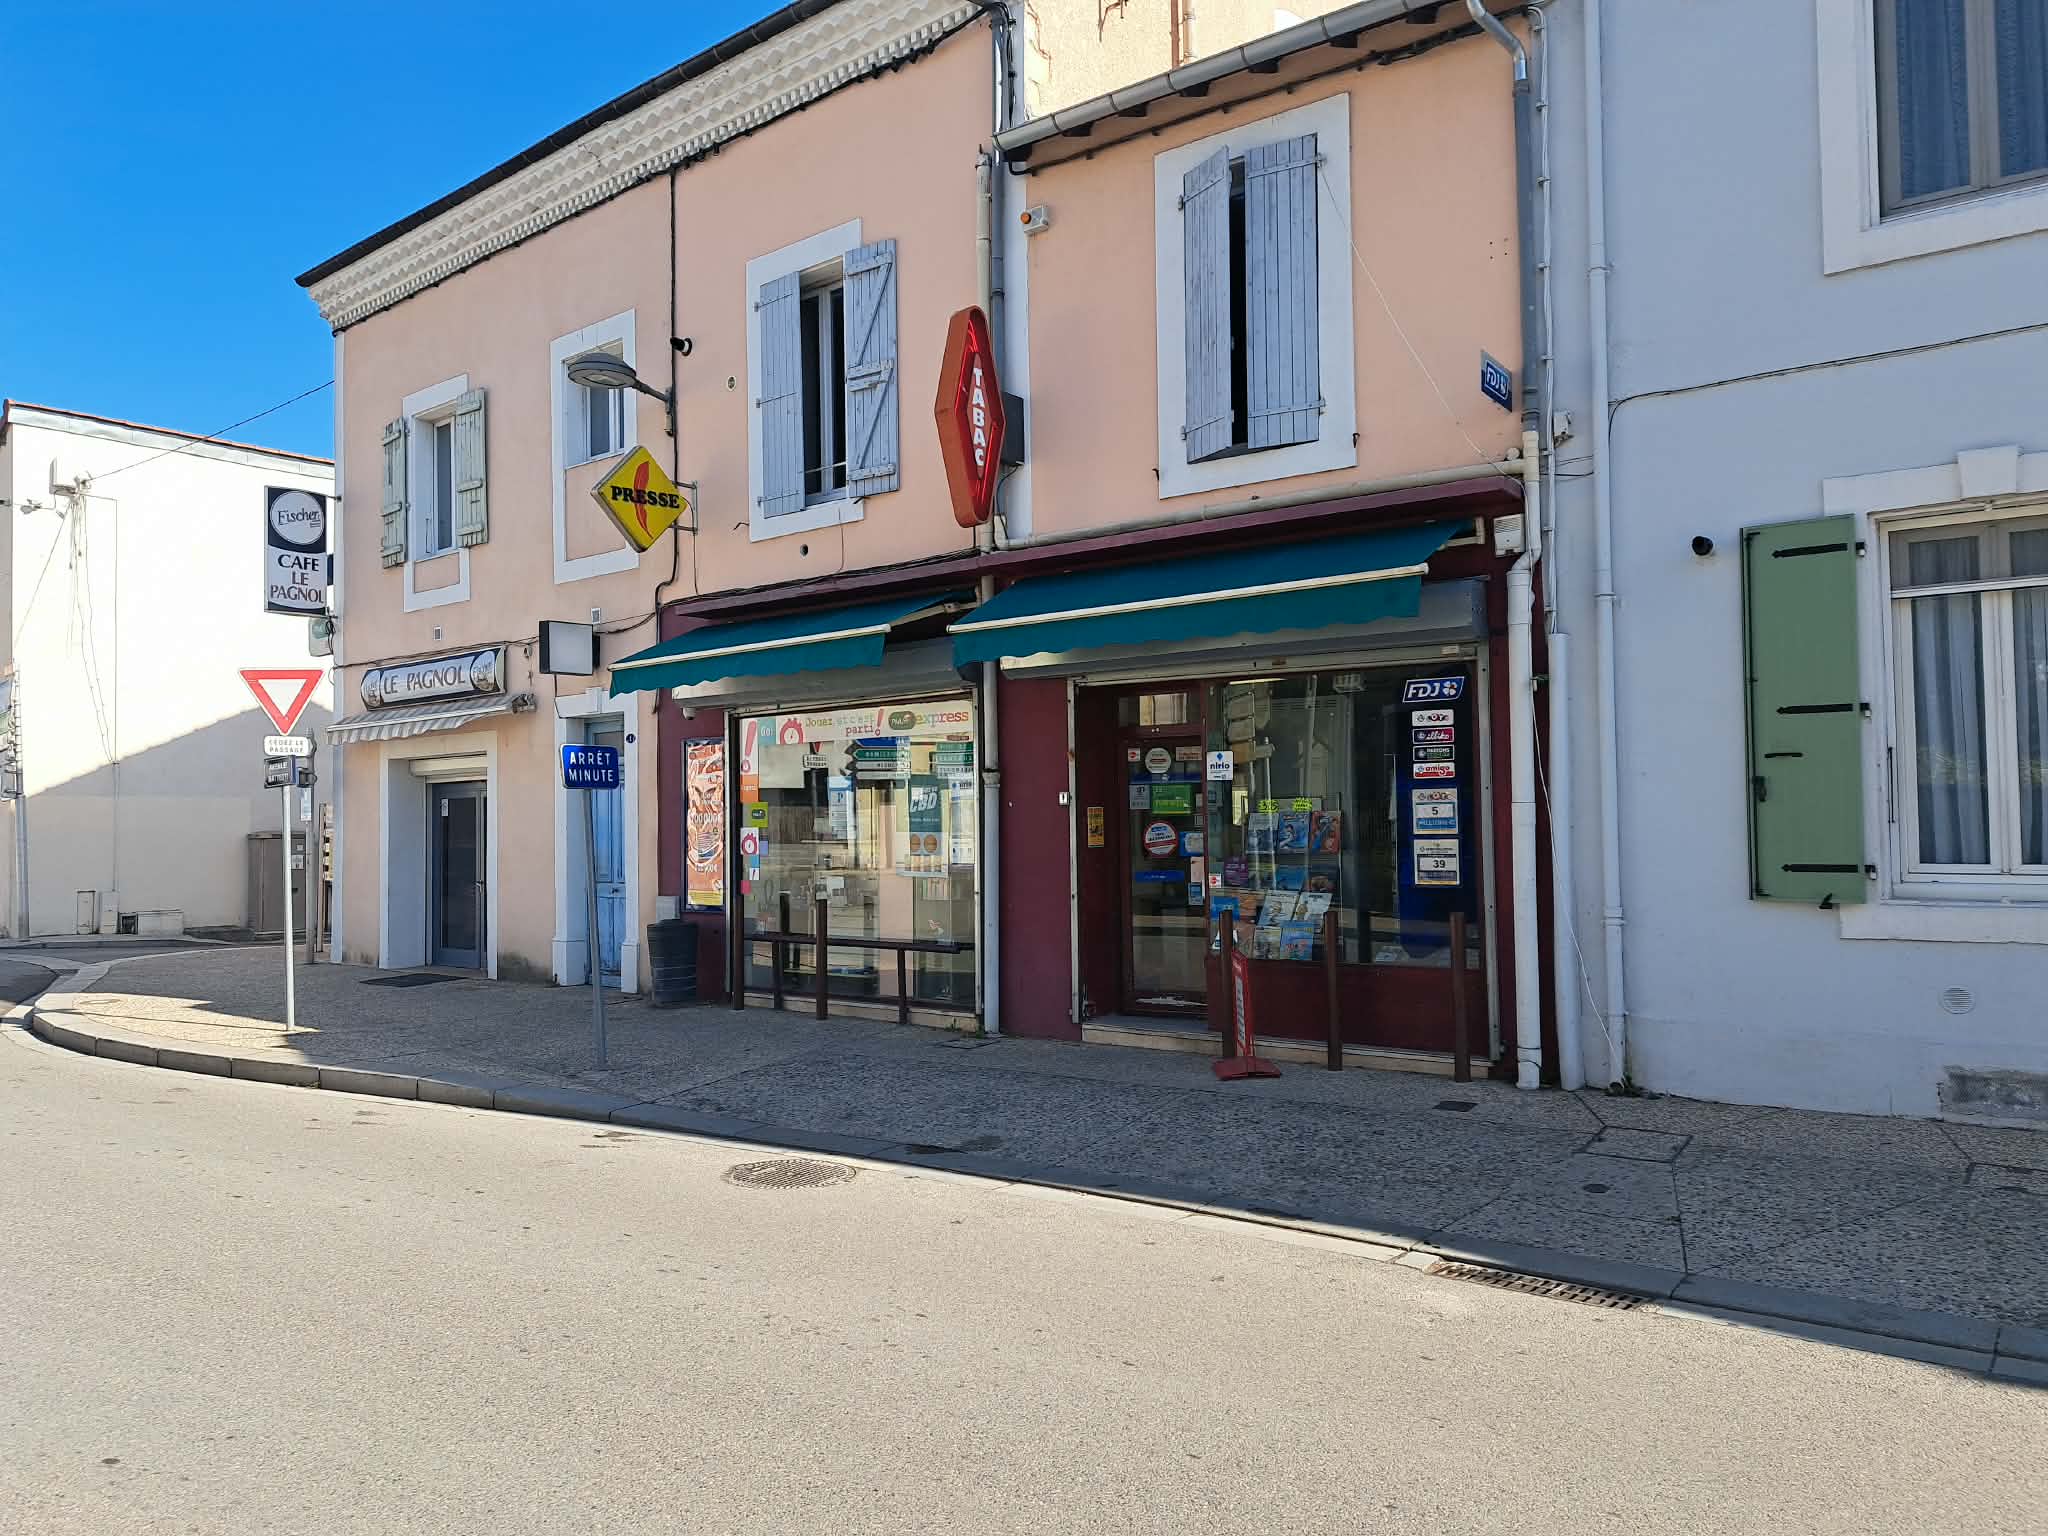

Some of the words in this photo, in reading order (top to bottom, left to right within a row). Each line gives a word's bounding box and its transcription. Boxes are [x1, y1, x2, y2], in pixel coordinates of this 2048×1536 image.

[973, 368, 986, 466] TABAC
[610, 485, 680, 509] PRESSE
[277, 507, 320, 525] Fischer
[278, 554, 320, 571] CAFE
[291, 571, 309, 586] LE
[270, 585, 325, 603] PAGNOL
[383, 675, 398, 694] LE
[406, 666, 466, 691] PAGNOL
[1407, 682, 1441, 698] FDJ
[915, 711, 969, 727] express
[569, 750, 610, 766] ARRÊT
[568, 768, 614, 783] MINUTE
[910, 792, 938, 812] CBD
[1431, 806, 1439, 816] 5
[1432, 859, 1446, 869] 39
